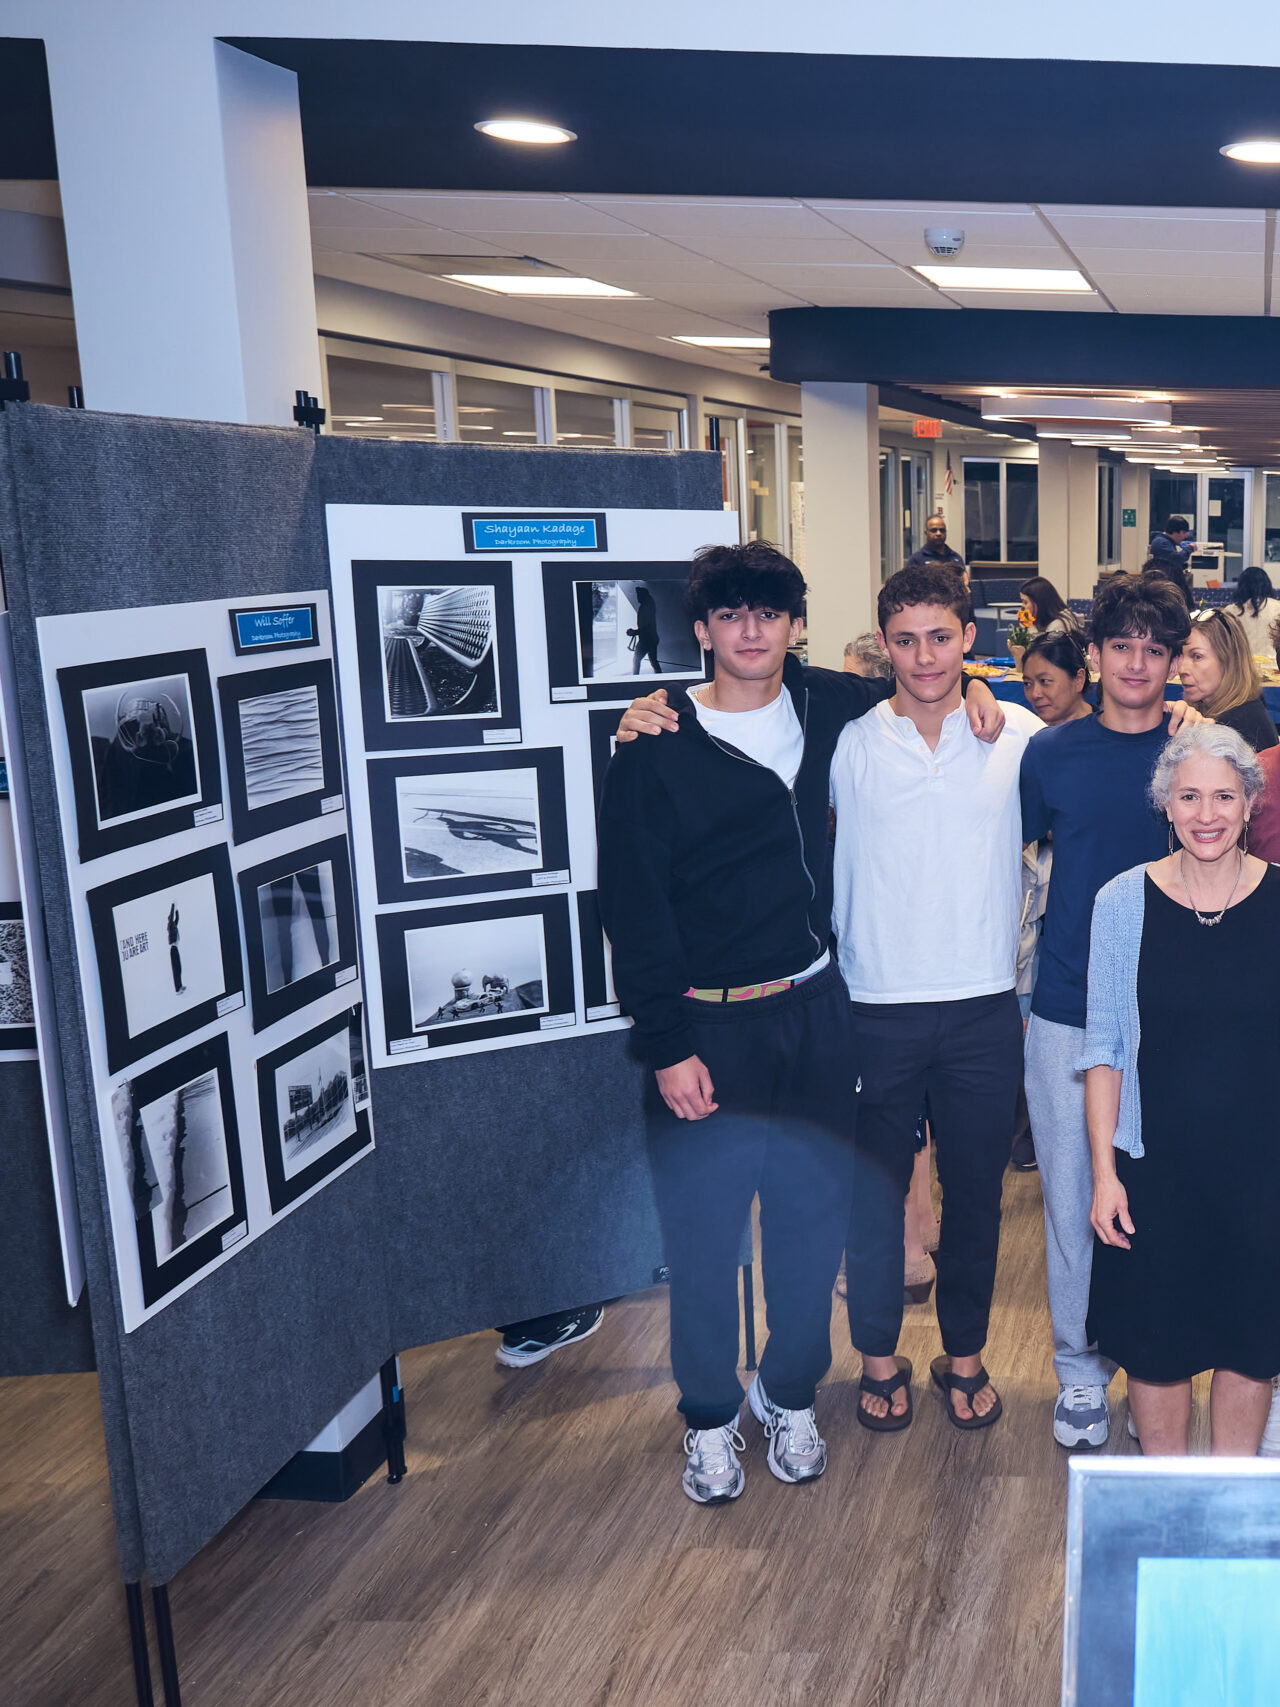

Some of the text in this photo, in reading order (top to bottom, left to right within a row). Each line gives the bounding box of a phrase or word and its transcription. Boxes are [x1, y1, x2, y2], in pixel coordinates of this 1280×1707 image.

[917, 419, 939, 438] EXIT
[484, 523, 585, 538] Shayaan Kadage
[532, 538, 577, 547] Photography
[254, 613, 295, 629] Will Soffer
